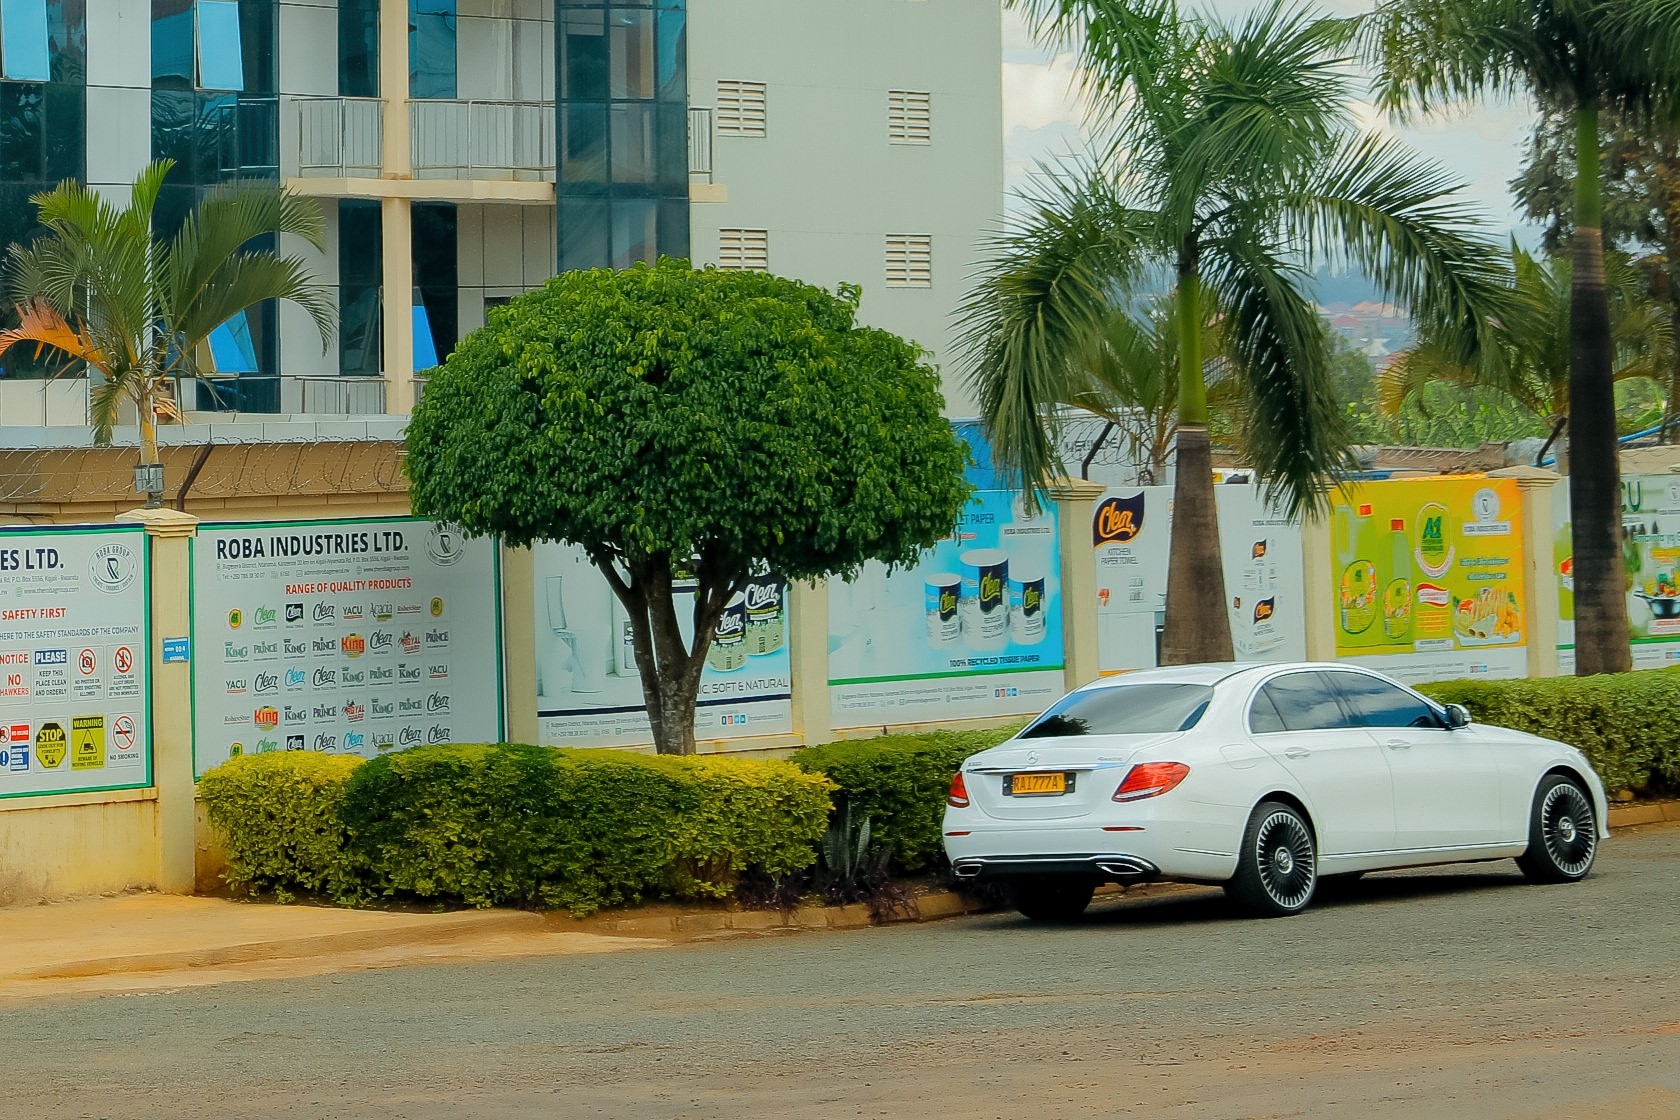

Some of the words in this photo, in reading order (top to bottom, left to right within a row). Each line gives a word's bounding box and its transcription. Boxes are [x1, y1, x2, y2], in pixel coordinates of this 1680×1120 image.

[970, 513, 994, 524] PAPER
[1099, 501, 1137, 538] Clear
[1422, 516, 1442, 539] A1
[216, 538, 265, 559] ROBA
[270, 532, 369, 557] INDUSTRIES
[373, 531, 409, 552] LTD.
[25, 548, 64, 570] LTD.
[285, 583, 315, 594] RANGE
[316, 582, 328, 593] OF
[329, 580, 366, 594] QUALITY
[368, 578, 412, 590] PRODUCTS
[745, 583, 780, 609] Clear
[1, 608, 37, 620] SAFETY
[40, 607, 67, 618] FIRST
[342, 606, 363, 615] YACU
[715, 611, 743, 635] lear
[15, 631, 23, 639] TO
[24, 631, 35, 639] THE
[35, 630, 57, 638] SAFETY
[57, 628, 91, 637] STANDARDS
[91, 628, 99, 636] OF
[100, 627, 111, 635] THE
[111, 626, 139, 634] COMPANY
[0, 653, 28, 664] NOTICE
[35, 651, 66, 663] PLEASE
[949, 659, 967, 667] 100%
[967, 657, 999, 666] RECYCLED
[999, 656, 1020, 664] TISSUE
[1020, 654, 1040, 662] PAPER
[428, 665, 448, 674] YACU
[7, 674, 21, 686] NO
[225, 680, 247, 689] YACU
[712, 682, 736, 694] SOFT
[745, 678, 788, 690] NATURAL
[0, 687, 29, 696] HAWKERS
[73, 719, 102, 728] WARNING
[39, 729, 63, 741] STOP
